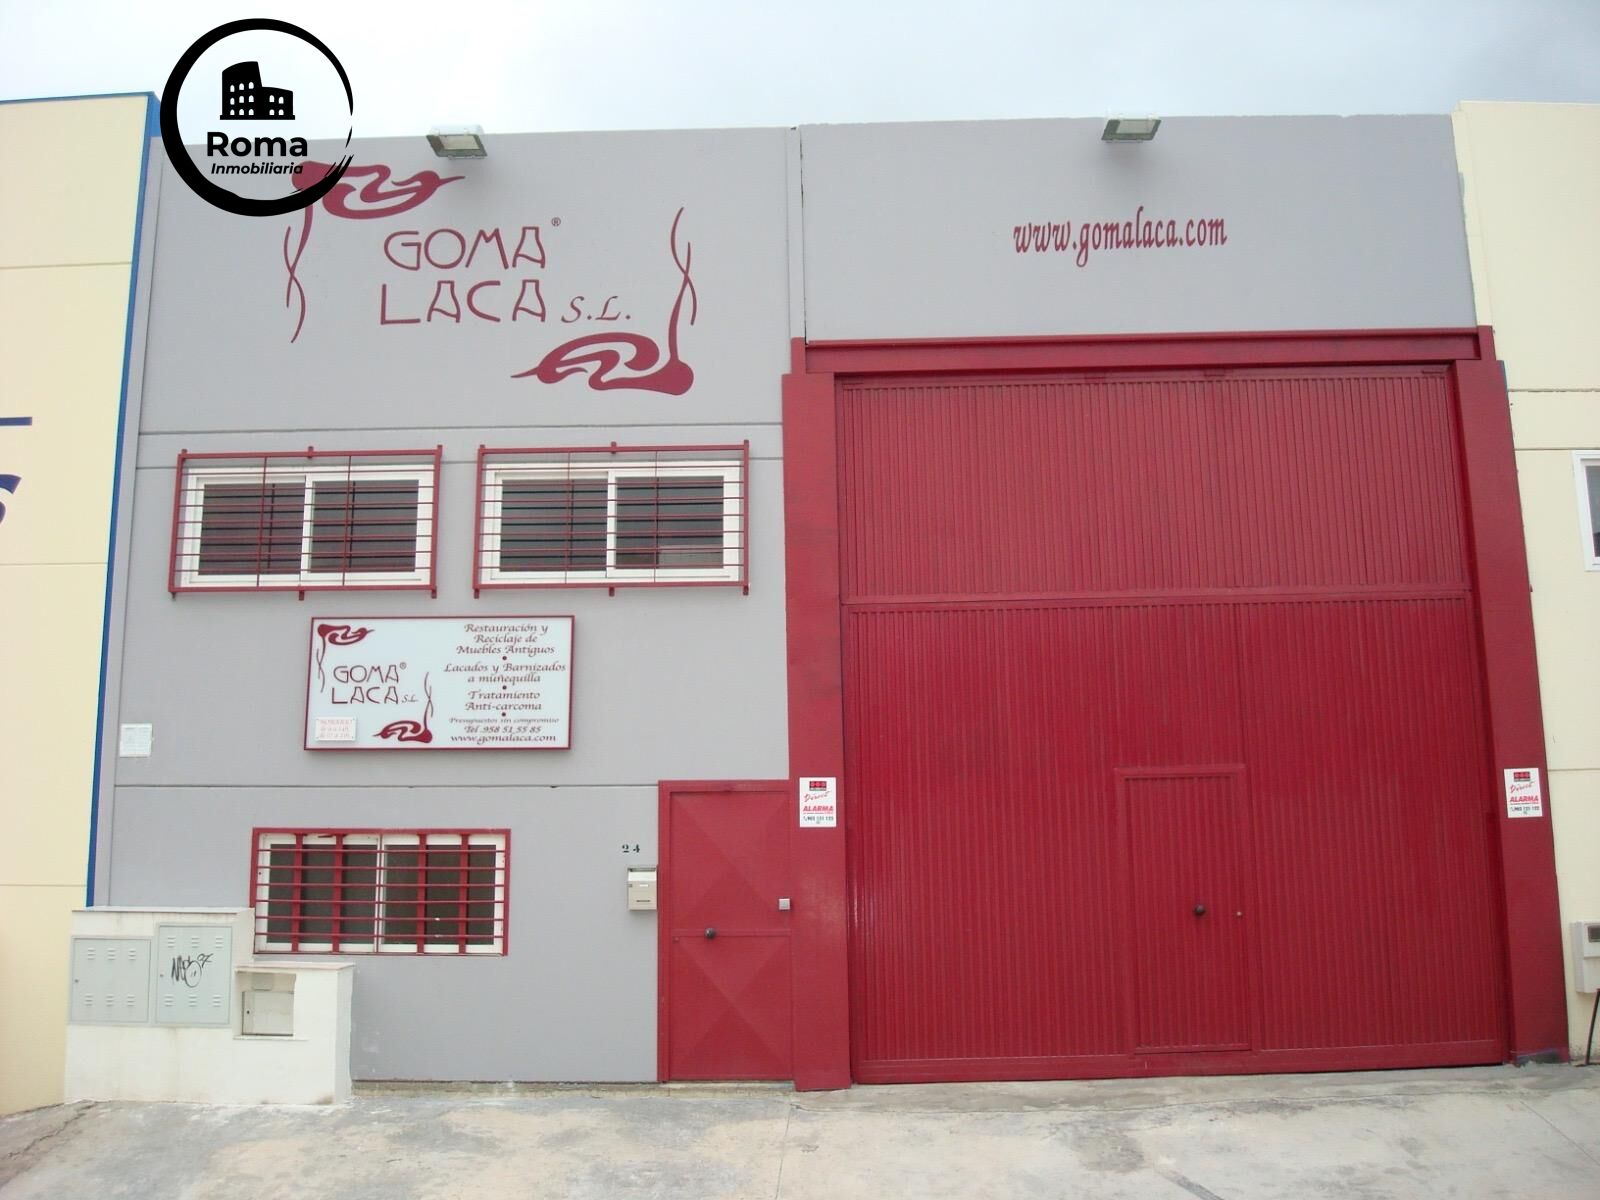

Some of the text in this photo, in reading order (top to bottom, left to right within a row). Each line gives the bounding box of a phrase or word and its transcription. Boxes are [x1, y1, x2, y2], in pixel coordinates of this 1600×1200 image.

[1013, 206, 1228, 268] www.gomalaca.com
[380, 279, 632, 326] LACA S.L.
[464, 623, 549, 636] Restauración y
[473, 634, 538, 645] Reciclaje de
[456, 644, 555, 657] Muebles Antiguos
[444, 661, 566, 674] Lacados y Barnizados
[479, 672, 541, 685] muñequilla
[332, 686, 399, 705] LACA
[467, 690, 541, 700] Tratamiento
[465, 702, 542, 711] Anti-carcoma
[450, 733, 556, 745] www.gomalaca.com
[1510, 795, 1539, 803] ALARMA
